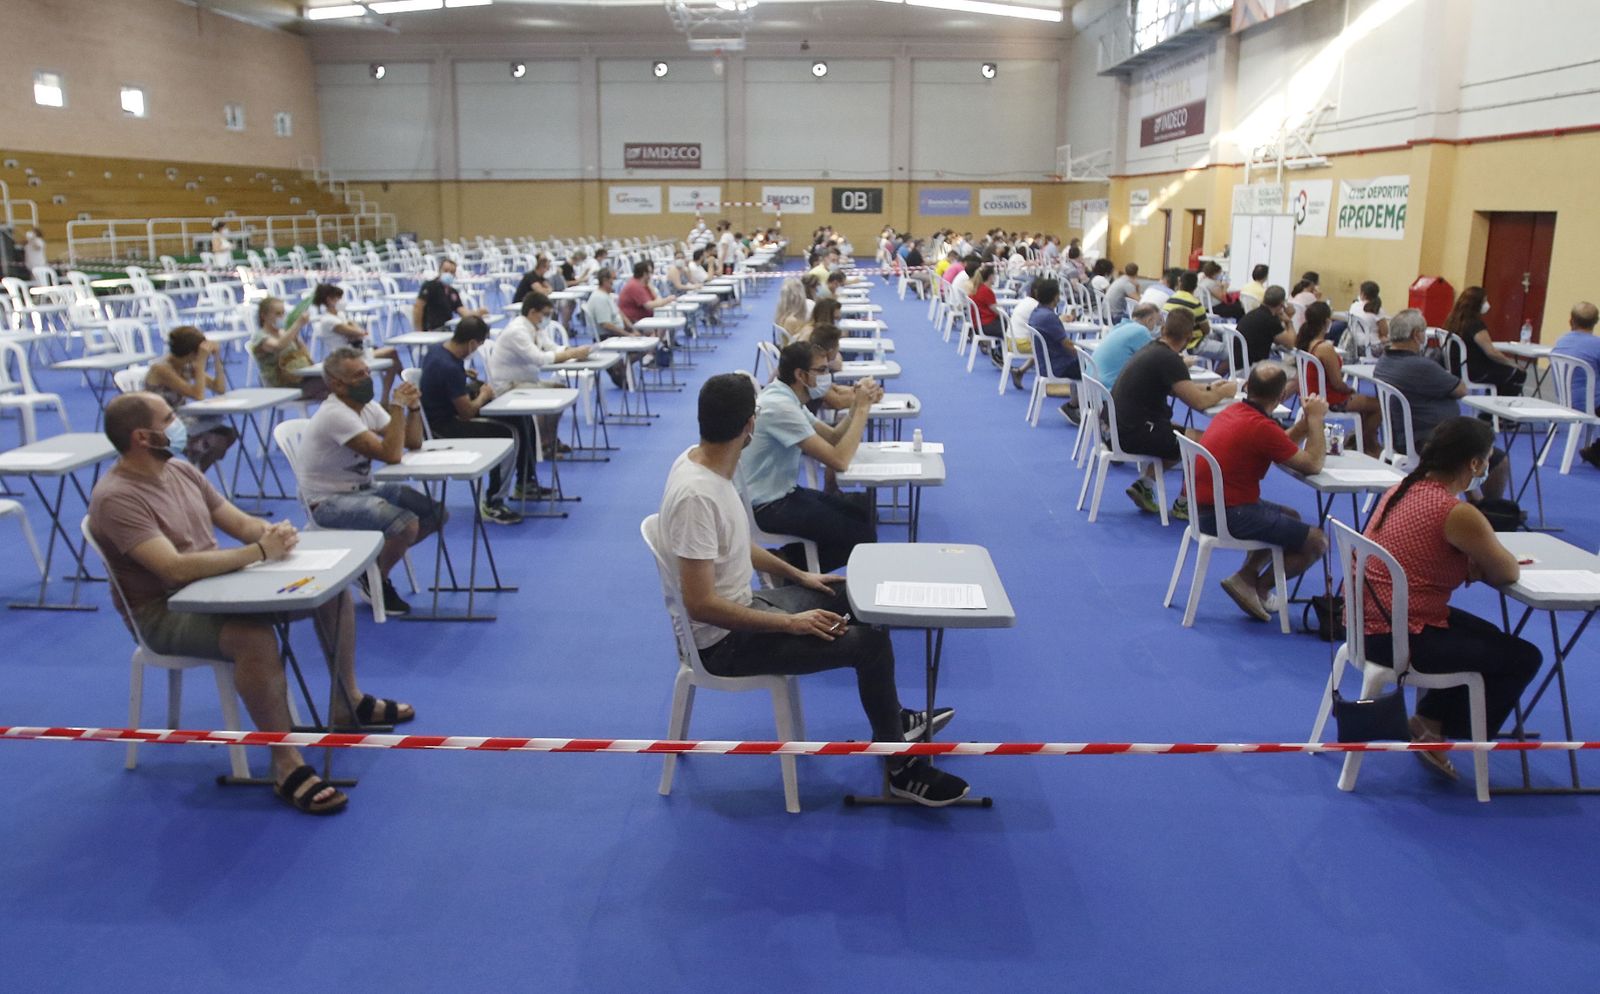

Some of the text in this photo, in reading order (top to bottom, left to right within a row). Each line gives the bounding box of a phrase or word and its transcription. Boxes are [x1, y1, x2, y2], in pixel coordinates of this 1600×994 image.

[642, 146, 700, 159] IMDECO
[841, 191, 868, 210] OB
[983, 200, 1028, 210] COSMOS
[1338, 204, 1407, 231] APADEMA
